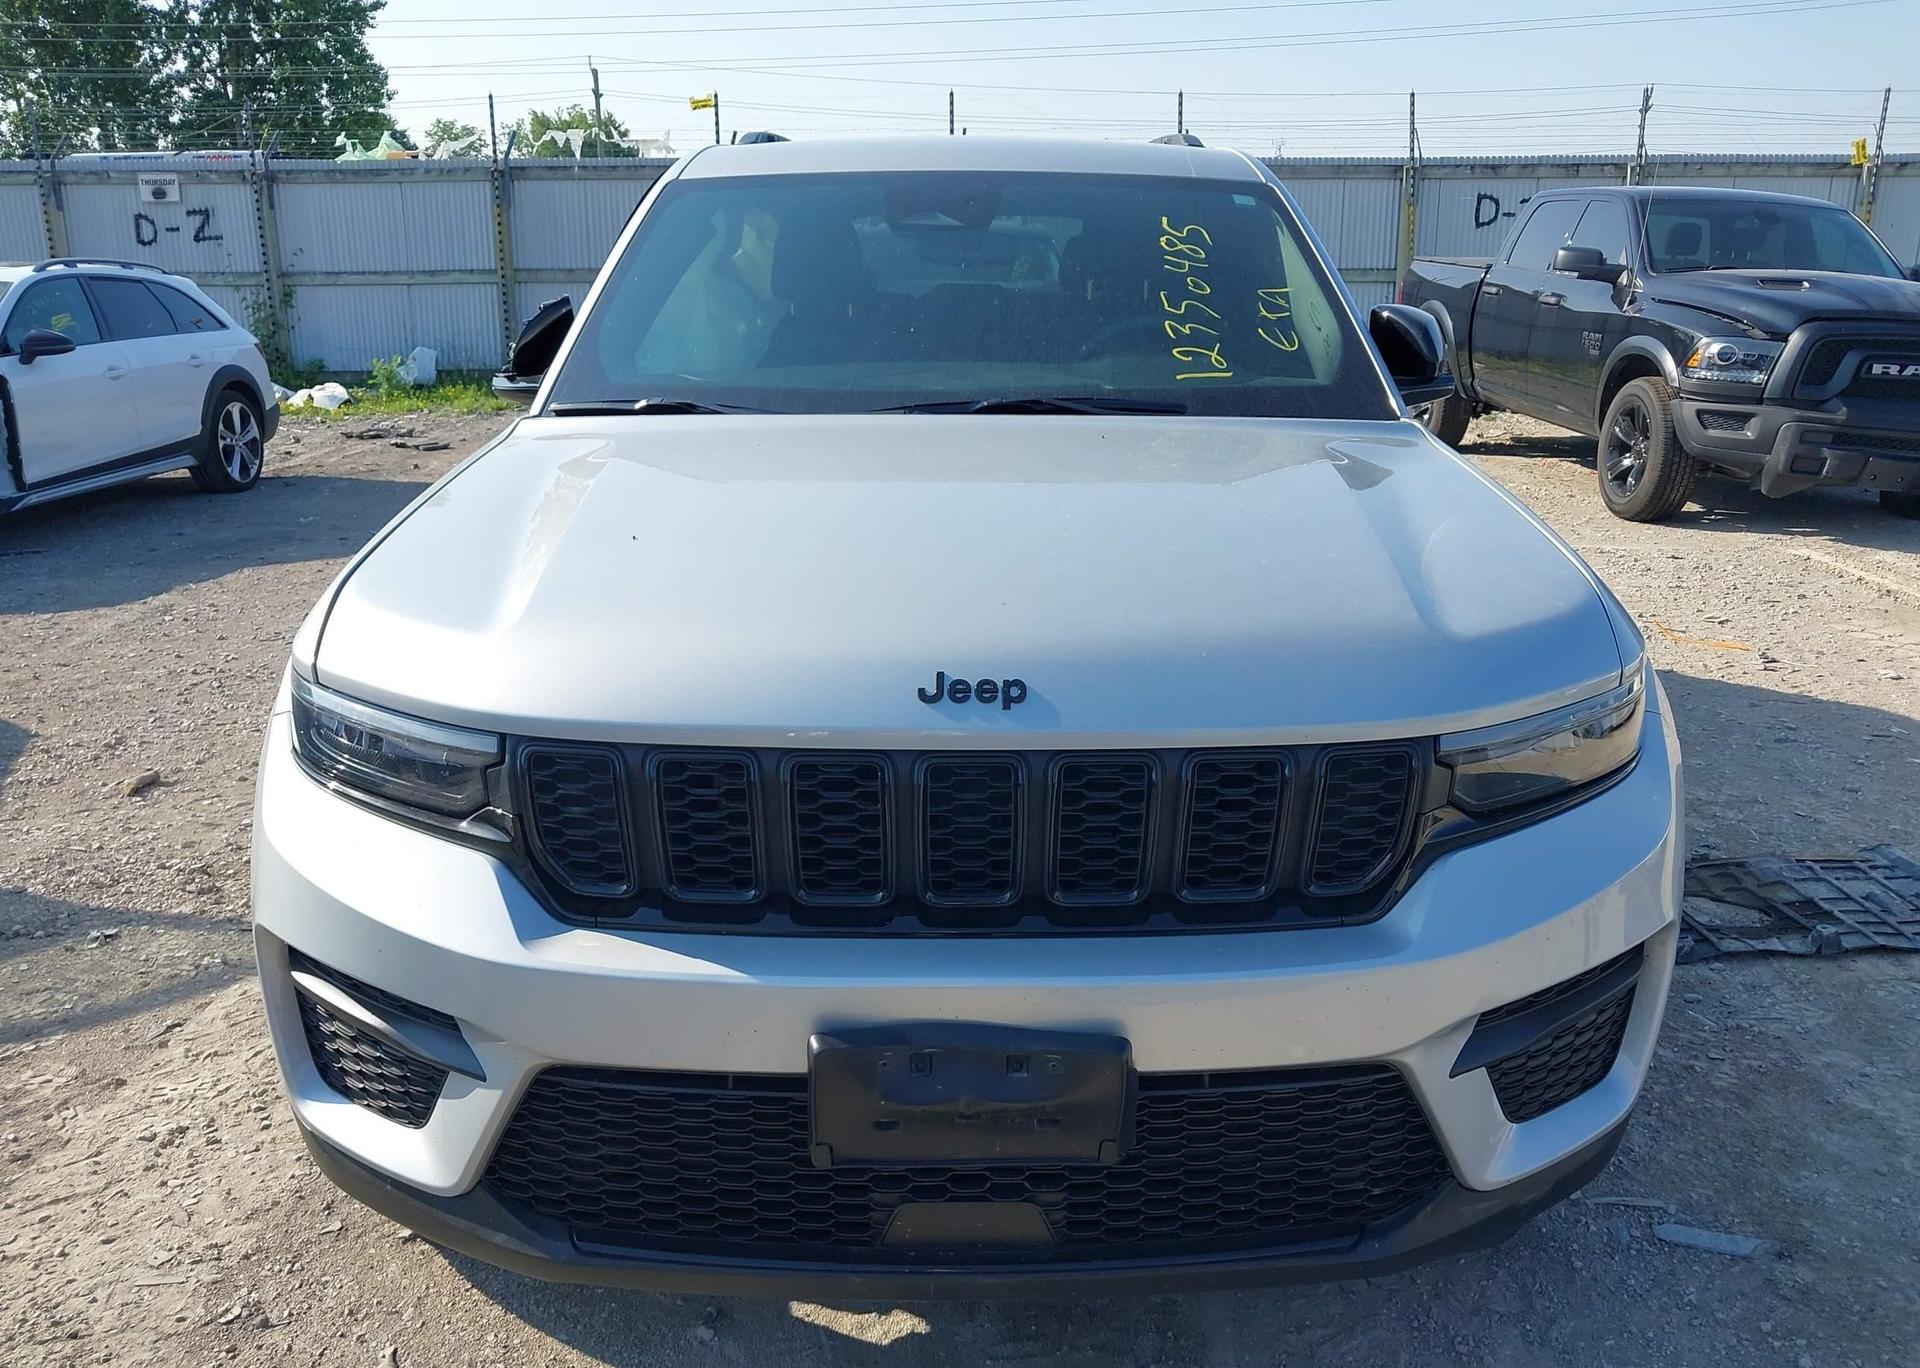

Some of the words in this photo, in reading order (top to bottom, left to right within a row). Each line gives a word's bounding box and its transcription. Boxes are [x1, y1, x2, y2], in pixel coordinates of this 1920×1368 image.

[140, 178, 176, 186] THURSDAY
[1475, 193, 1532, 229] D-
[1160, 216, 1233, 380] 12350485
[1582, 331, 1602, 341] RAM
[1872, 363, 1920, 376] RA
[917, 671, 1028, 711] Jeep
